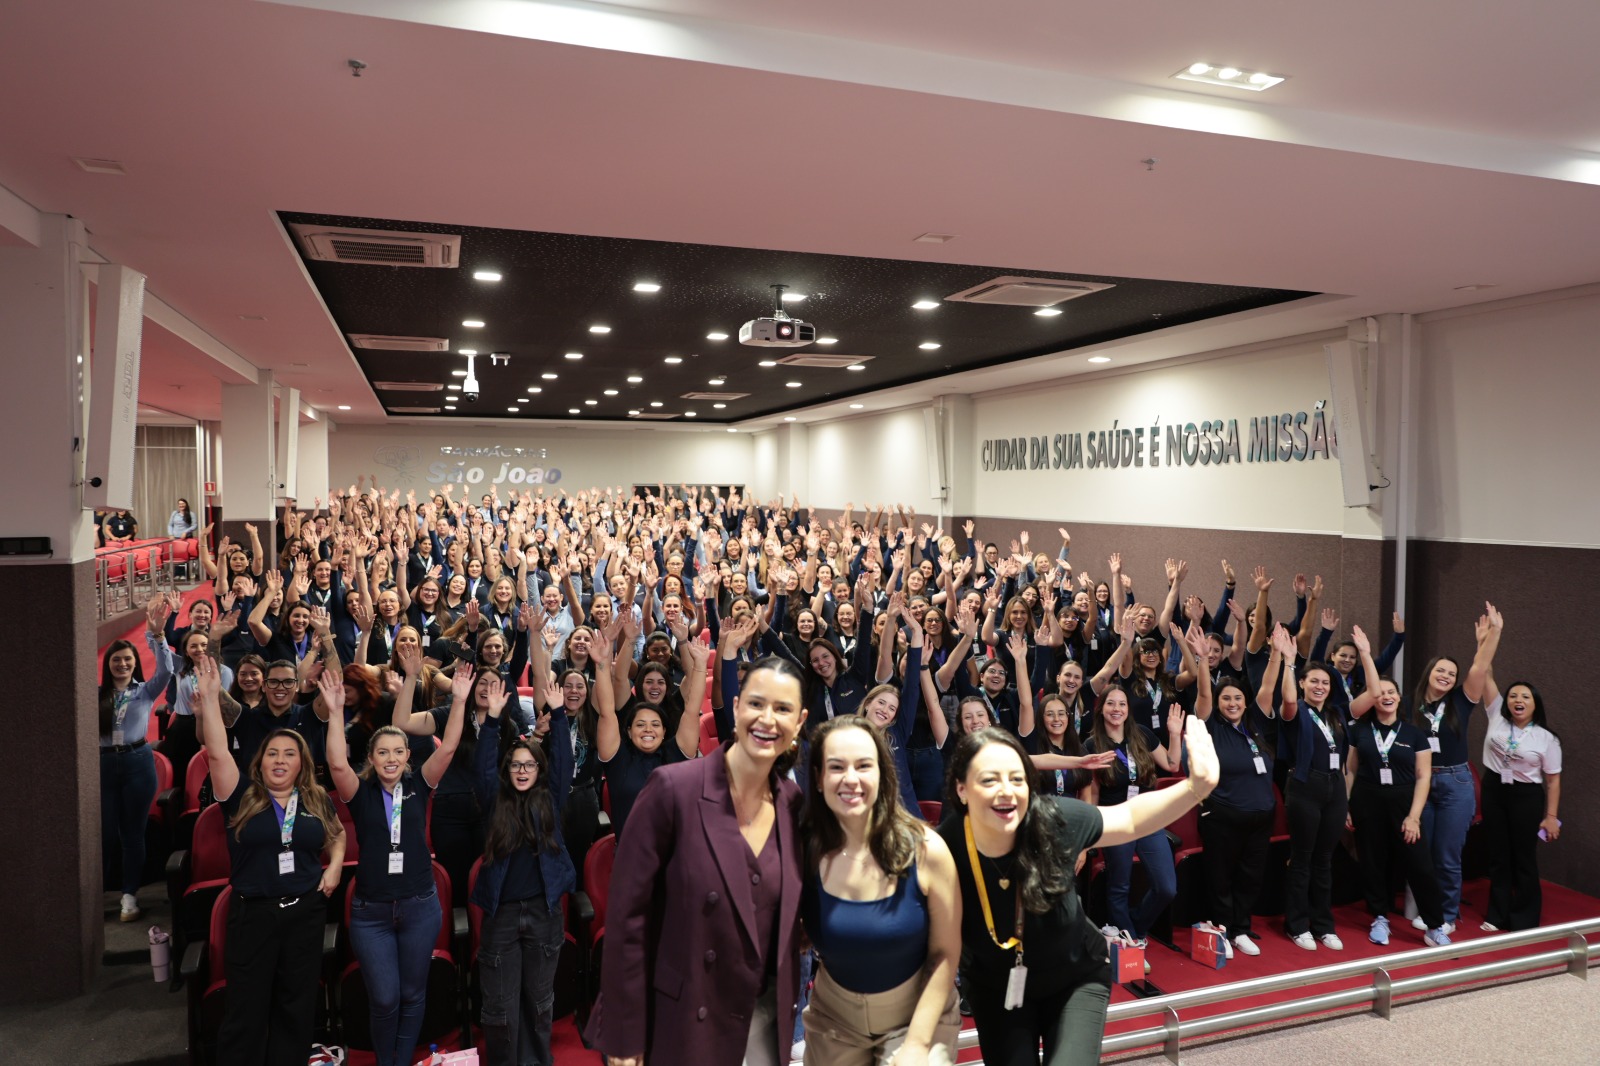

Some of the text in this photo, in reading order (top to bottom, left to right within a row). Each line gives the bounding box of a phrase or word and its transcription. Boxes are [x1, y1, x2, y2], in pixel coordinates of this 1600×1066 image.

[440, 445, 547, 458] FARMÁCIAS
[981, 437, 1027, 472] CUIDAR
[1030, 435, 1050, 471] DA
[1053, 432, 1084, 470] SUA
[1087, 419, 1145, 469] SAÚDE
[1150, 414, 1161, 467] É
[1166, 418, 1241, 466] NOSSA
[426, 461, 562, 484] São João
